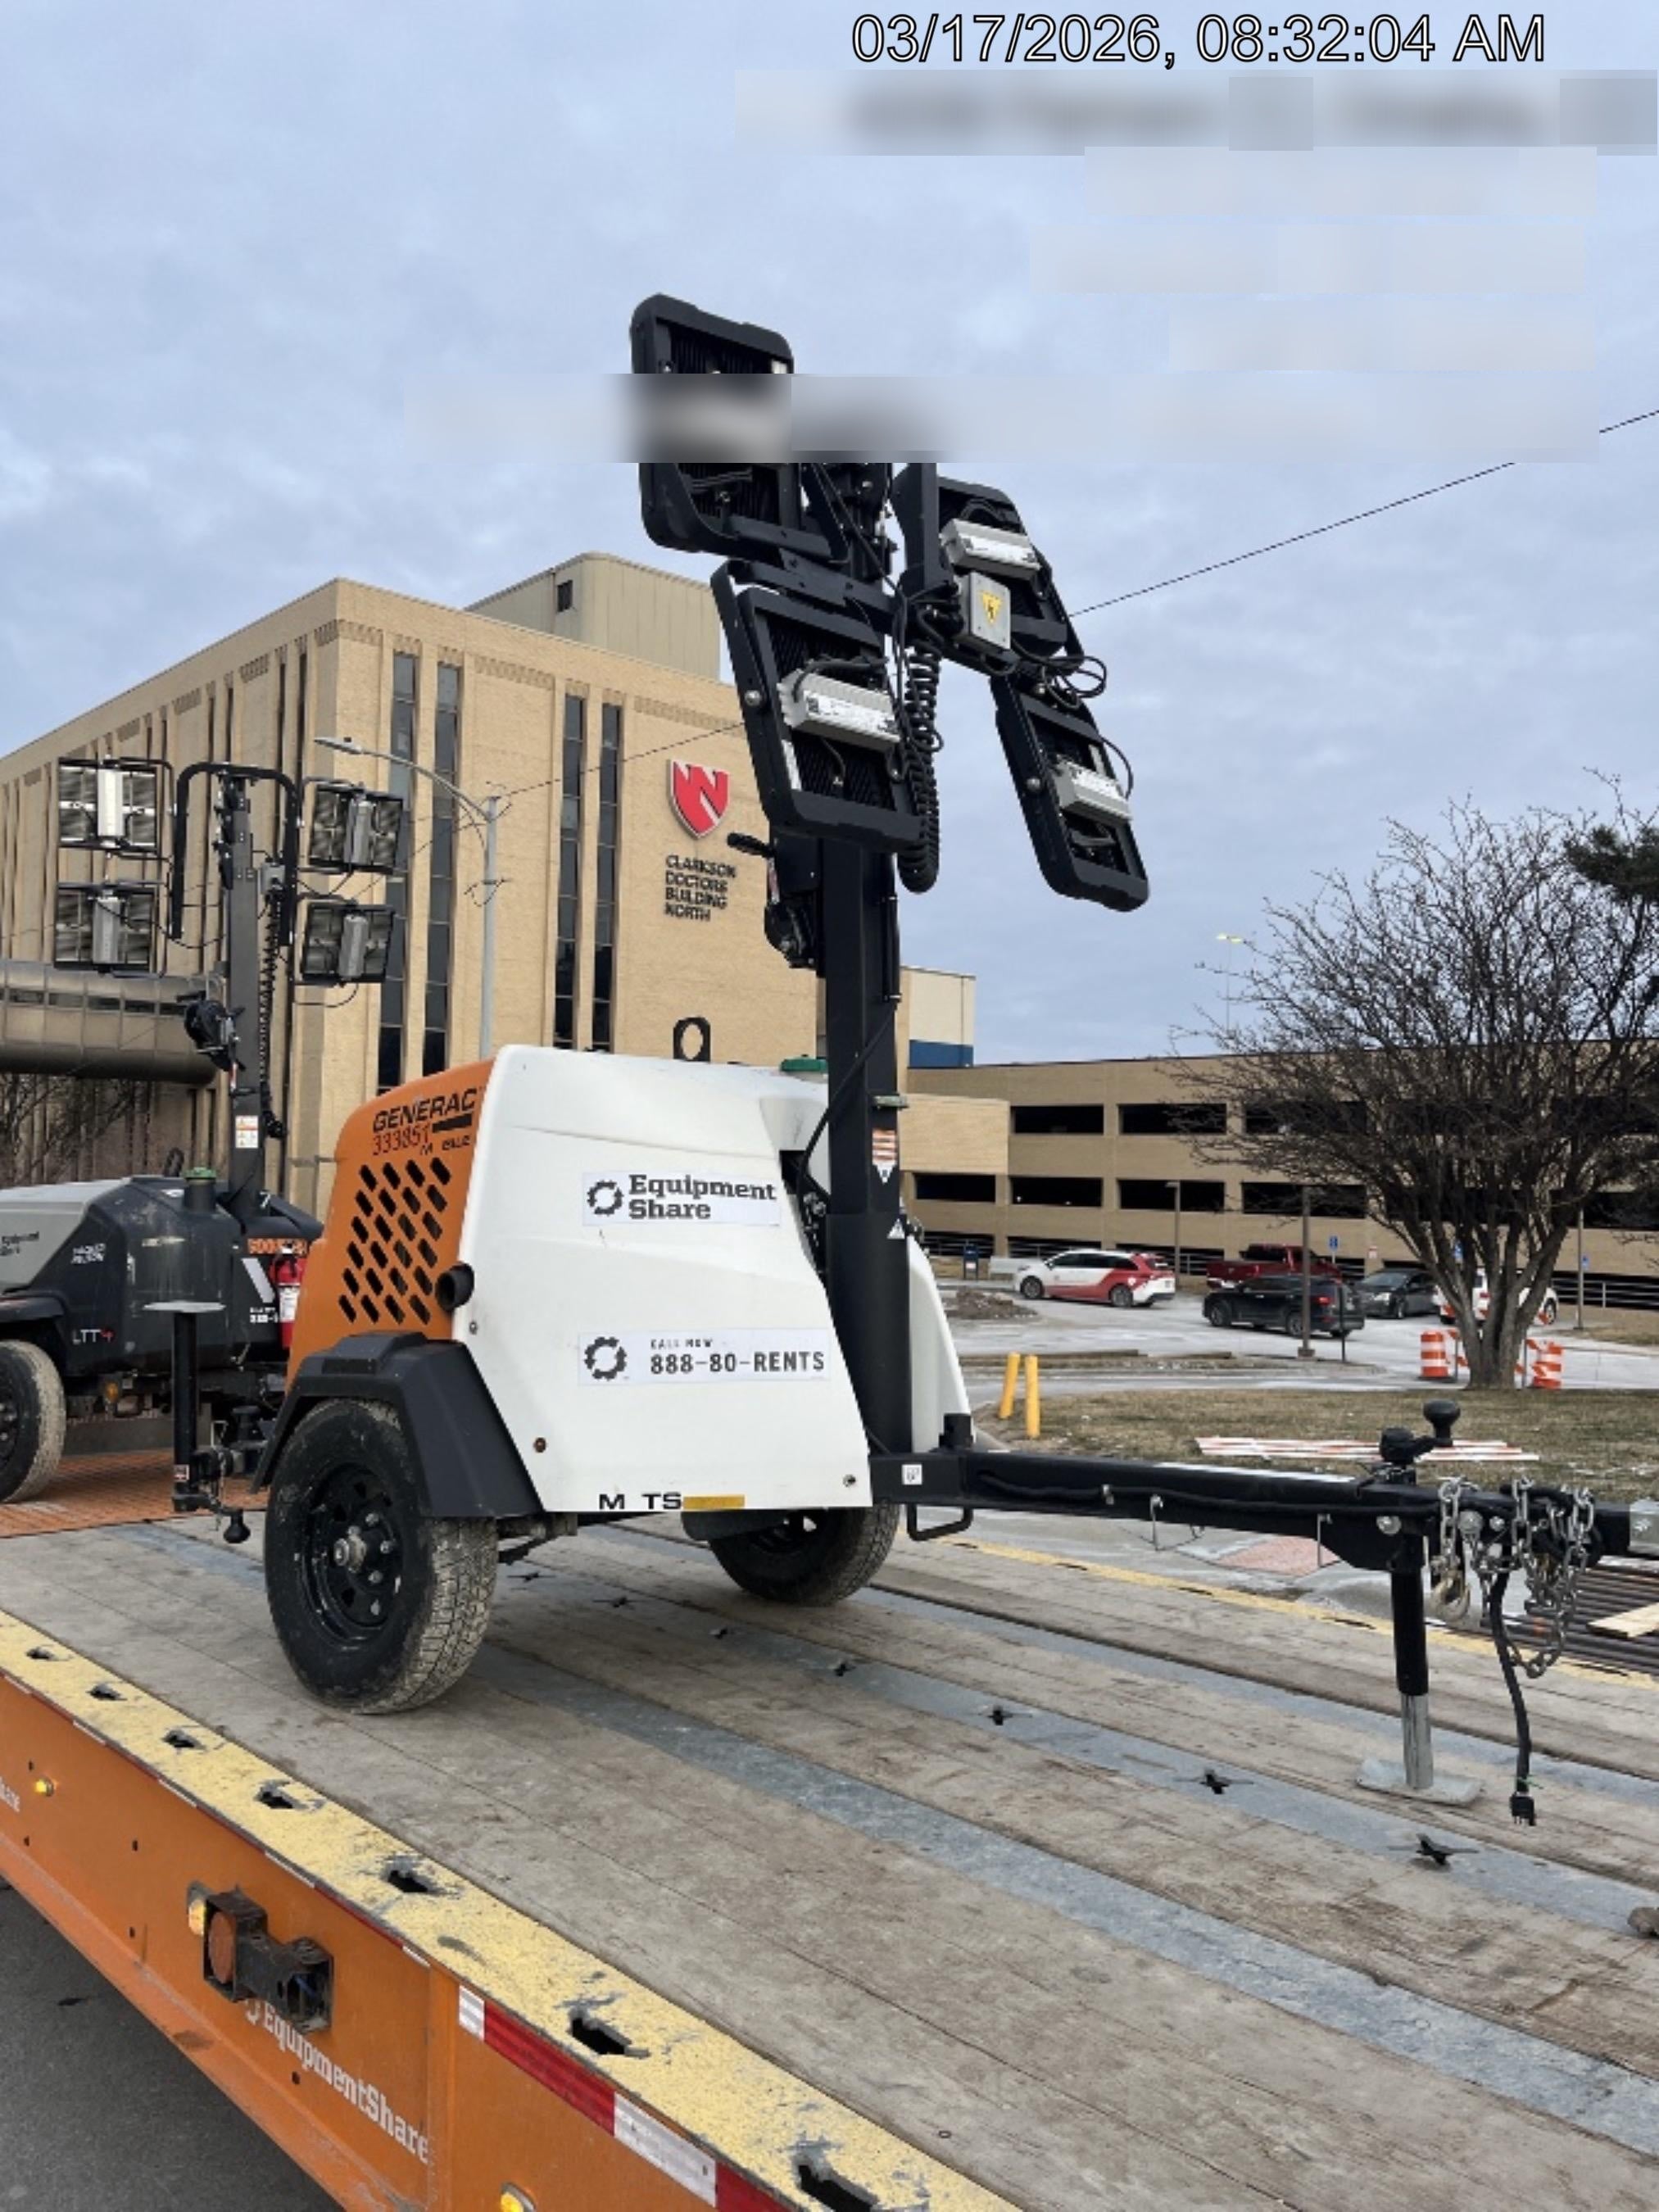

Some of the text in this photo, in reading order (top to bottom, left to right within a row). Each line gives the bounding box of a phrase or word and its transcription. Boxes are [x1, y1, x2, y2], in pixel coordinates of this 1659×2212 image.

[665, 855, 737, 879] CLARKSON
[665, 871, 728, 894] DOCTORS
[665, 886, 728, 909] BUILDING
[664, 903, 711, 922] NORTH
[373, 1088, 478, 1133] GENERAC
[372, 1123, 429, 1156] 333851
[628, 1174, 777, 1200] Equipment
[628, 1199, 711, 1220] Share
[650, 1350, 826, 1377] 888-80-RENTS
[263, 2002, 429, 2164] EquipmentShare
